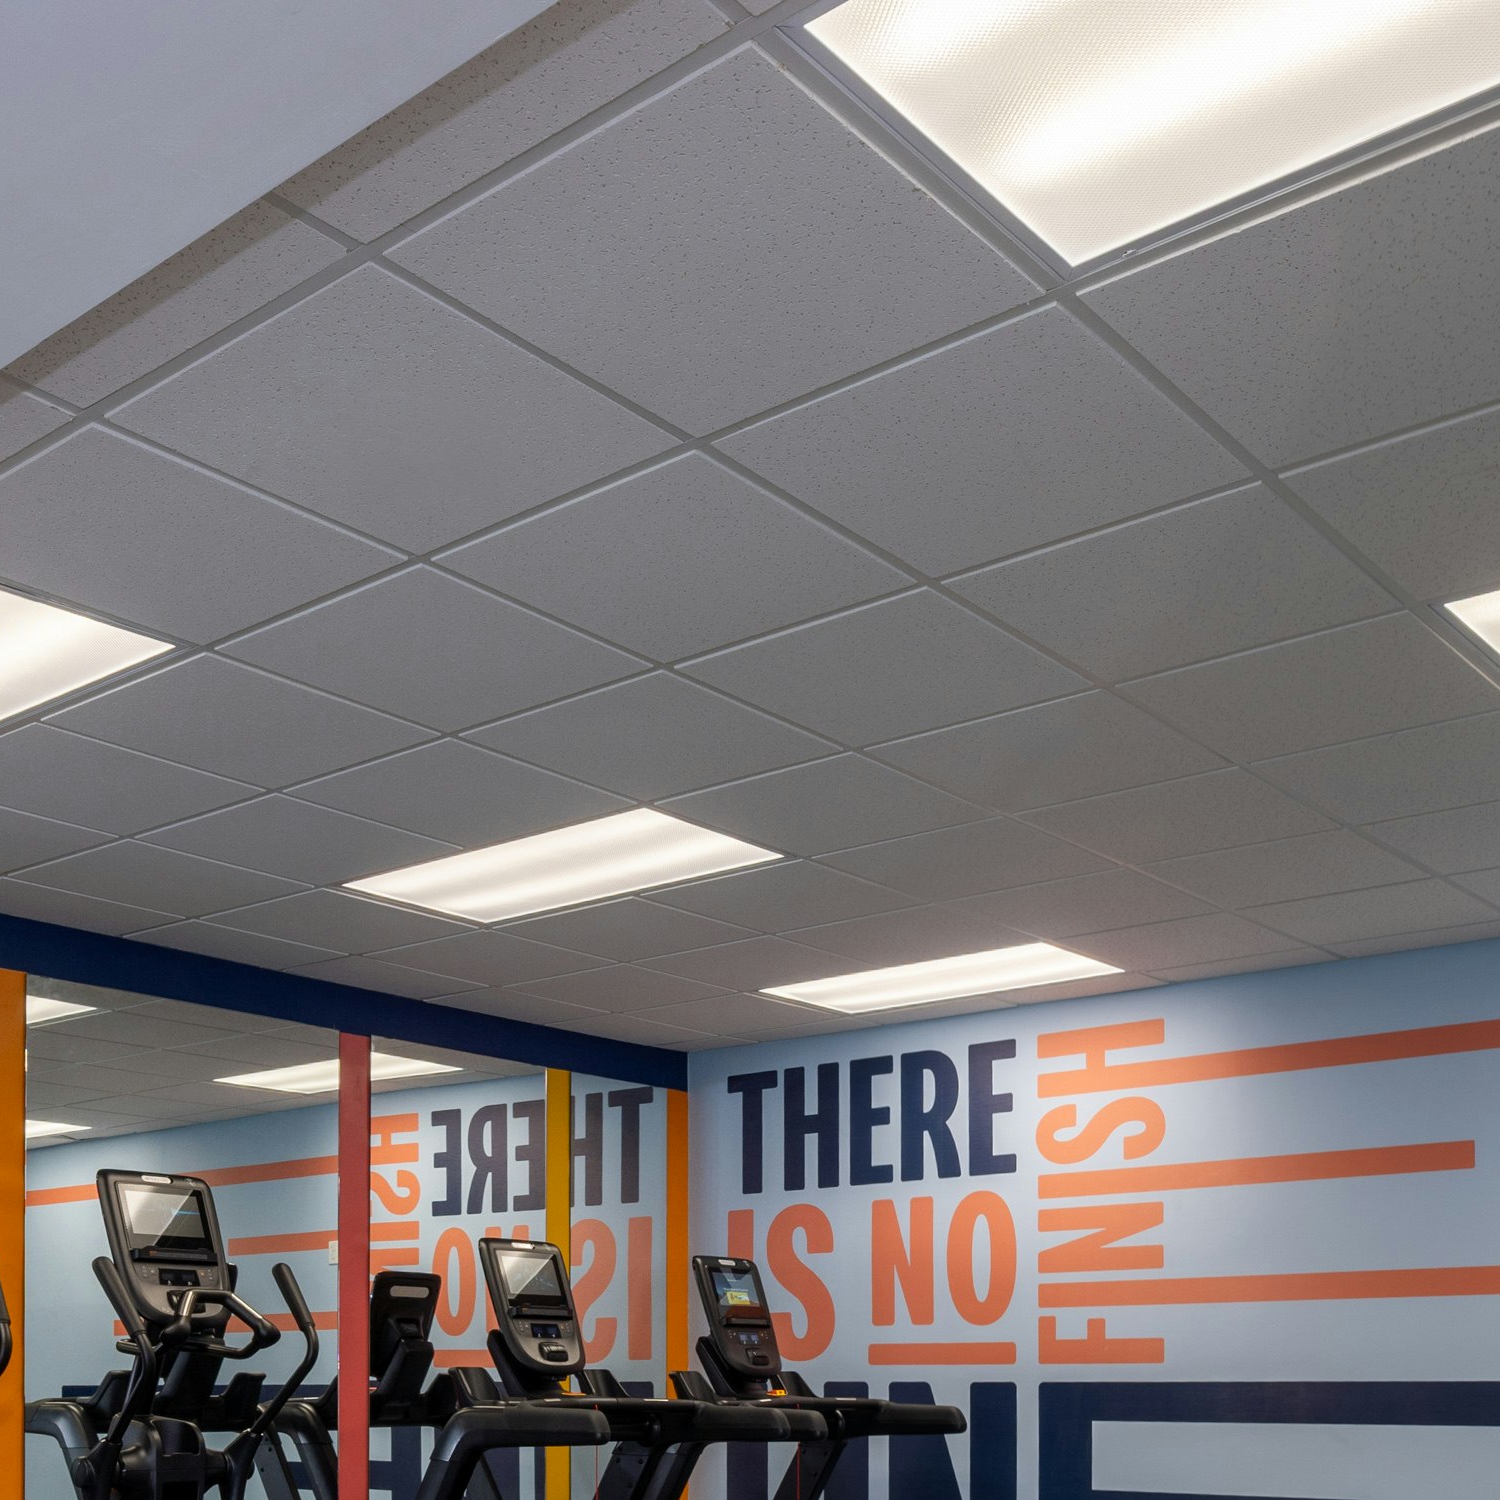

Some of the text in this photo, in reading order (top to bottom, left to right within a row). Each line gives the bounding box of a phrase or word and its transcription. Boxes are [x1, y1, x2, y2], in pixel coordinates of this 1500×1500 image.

[726, 1038, 1018, 1195] THERE
[1035, 1017, 1167, 1366] FINISH
[869, 1190, 1018, 1329] NO
